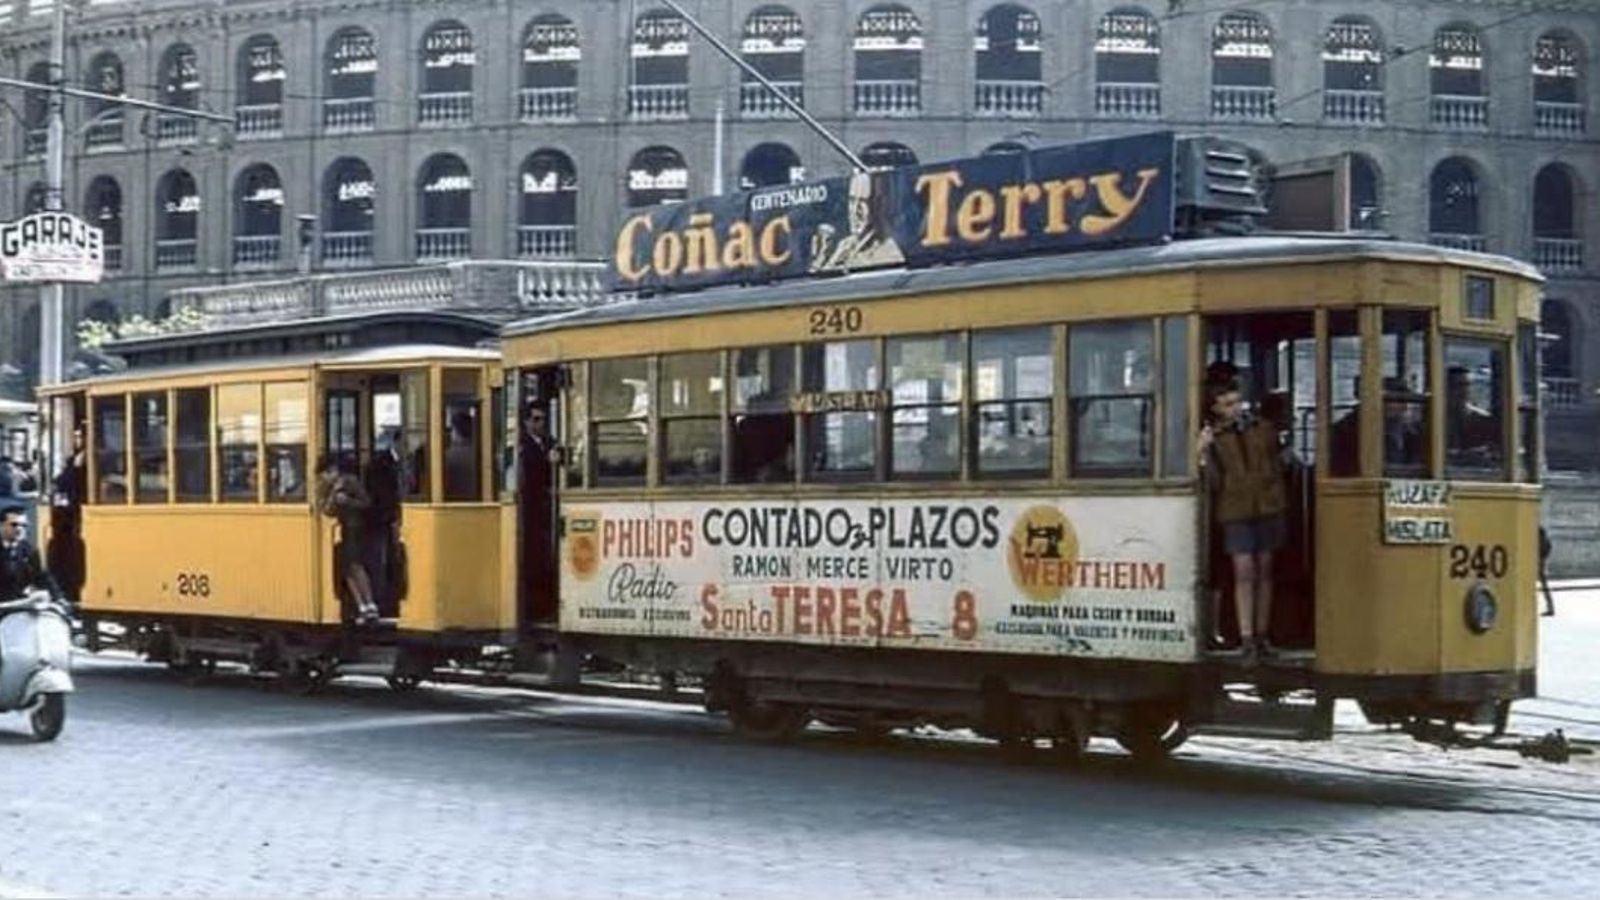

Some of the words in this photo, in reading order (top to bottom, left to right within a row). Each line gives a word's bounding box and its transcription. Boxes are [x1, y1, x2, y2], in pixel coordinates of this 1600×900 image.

[751, 185, 828, 212] CENTENARIO
[2, 216, 99, 260] GARAJE
[616, 213, 793, 281] Coñac
[915, 169, 1158, 246] Terry
[810, 307, 863, 335] 240
[602, 519, 694, 558] PHILIPS
[702, 507, 851, 548] CONTADO
[868, 506, 1000, 549] PLAZOS
[733, 554, 792, 577] RAMON
[807, 556, 869, 579] MERCE
[886, 557, 953, 580] VIRTO
[1009, 542, 1166, 590] WERTHEIM
[1450, 544, 1508, 578] 240
[178, 573, 211, 597] 208
[608, 562, 678, 603] Radio
[701, 583, 772, 633] Santa
[771, 586, 913, 639] TERESA
[952, 590, 978, 641] 8
